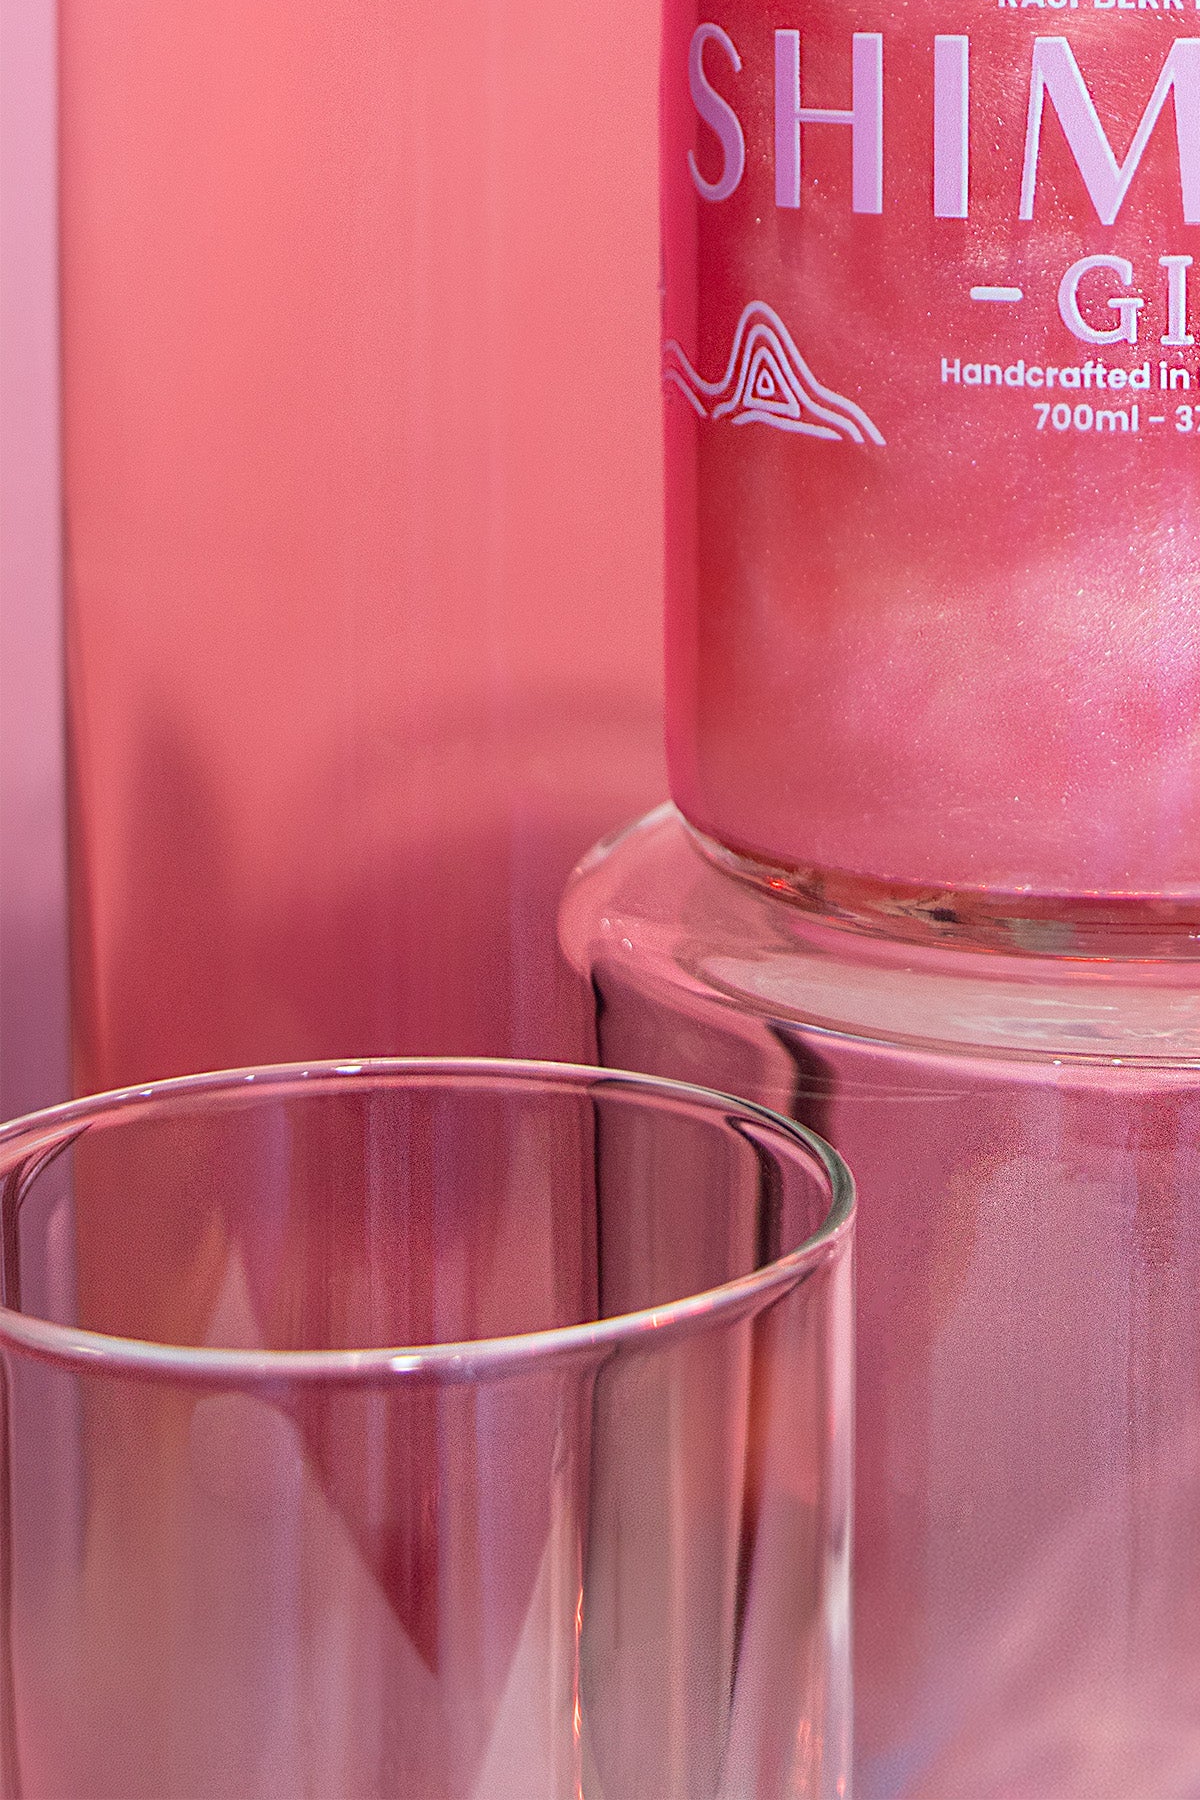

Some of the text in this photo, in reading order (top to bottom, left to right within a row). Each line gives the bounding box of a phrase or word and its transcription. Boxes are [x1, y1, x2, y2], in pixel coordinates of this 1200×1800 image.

[940, 357, 1151, 389] Handcrafted
[1159, 360, 1190, 388] in
[1033, 403, 1138, 431] 700ml
